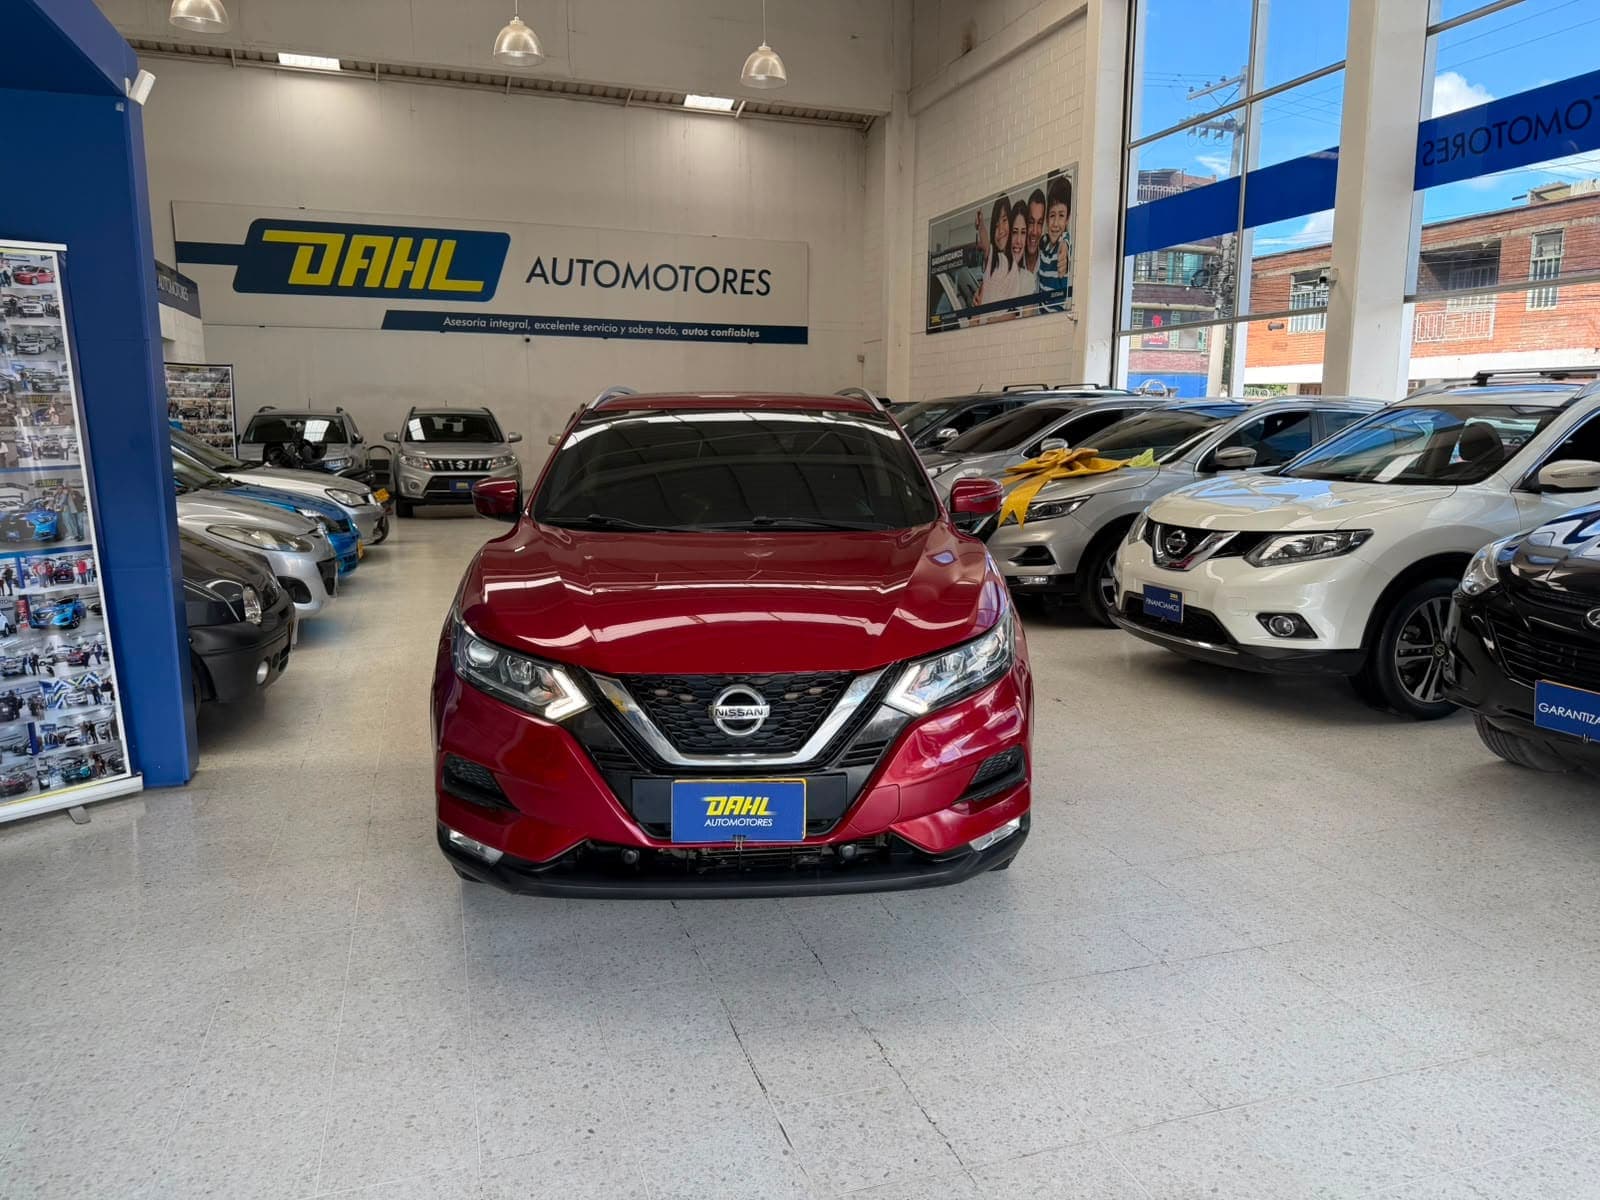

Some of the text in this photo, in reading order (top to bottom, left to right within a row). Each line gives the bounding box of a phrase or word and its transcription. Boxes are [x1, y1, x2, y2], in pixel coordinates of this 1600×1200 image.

[262, 229, 485, 292] DAHL
[525, 256, 771, 296] AUTOMOTORES
[489, 318, 531, 330] integral,
[534, 321, 580, 331] excelente
[583, 322, 618, 333] servicio
[619, 326, 626, 335] y
[628, 324, 653, 334] sobre
[656, 325, 679, 336] todo,
[682, 327, 708, 336] autos
[711, 328, 760, 338] confiables
[715, 708, 763, 717] NISSAN
[702, 796, 776, 816] DAHL
[703, 817, 773, 827] AUTOMOTORES
